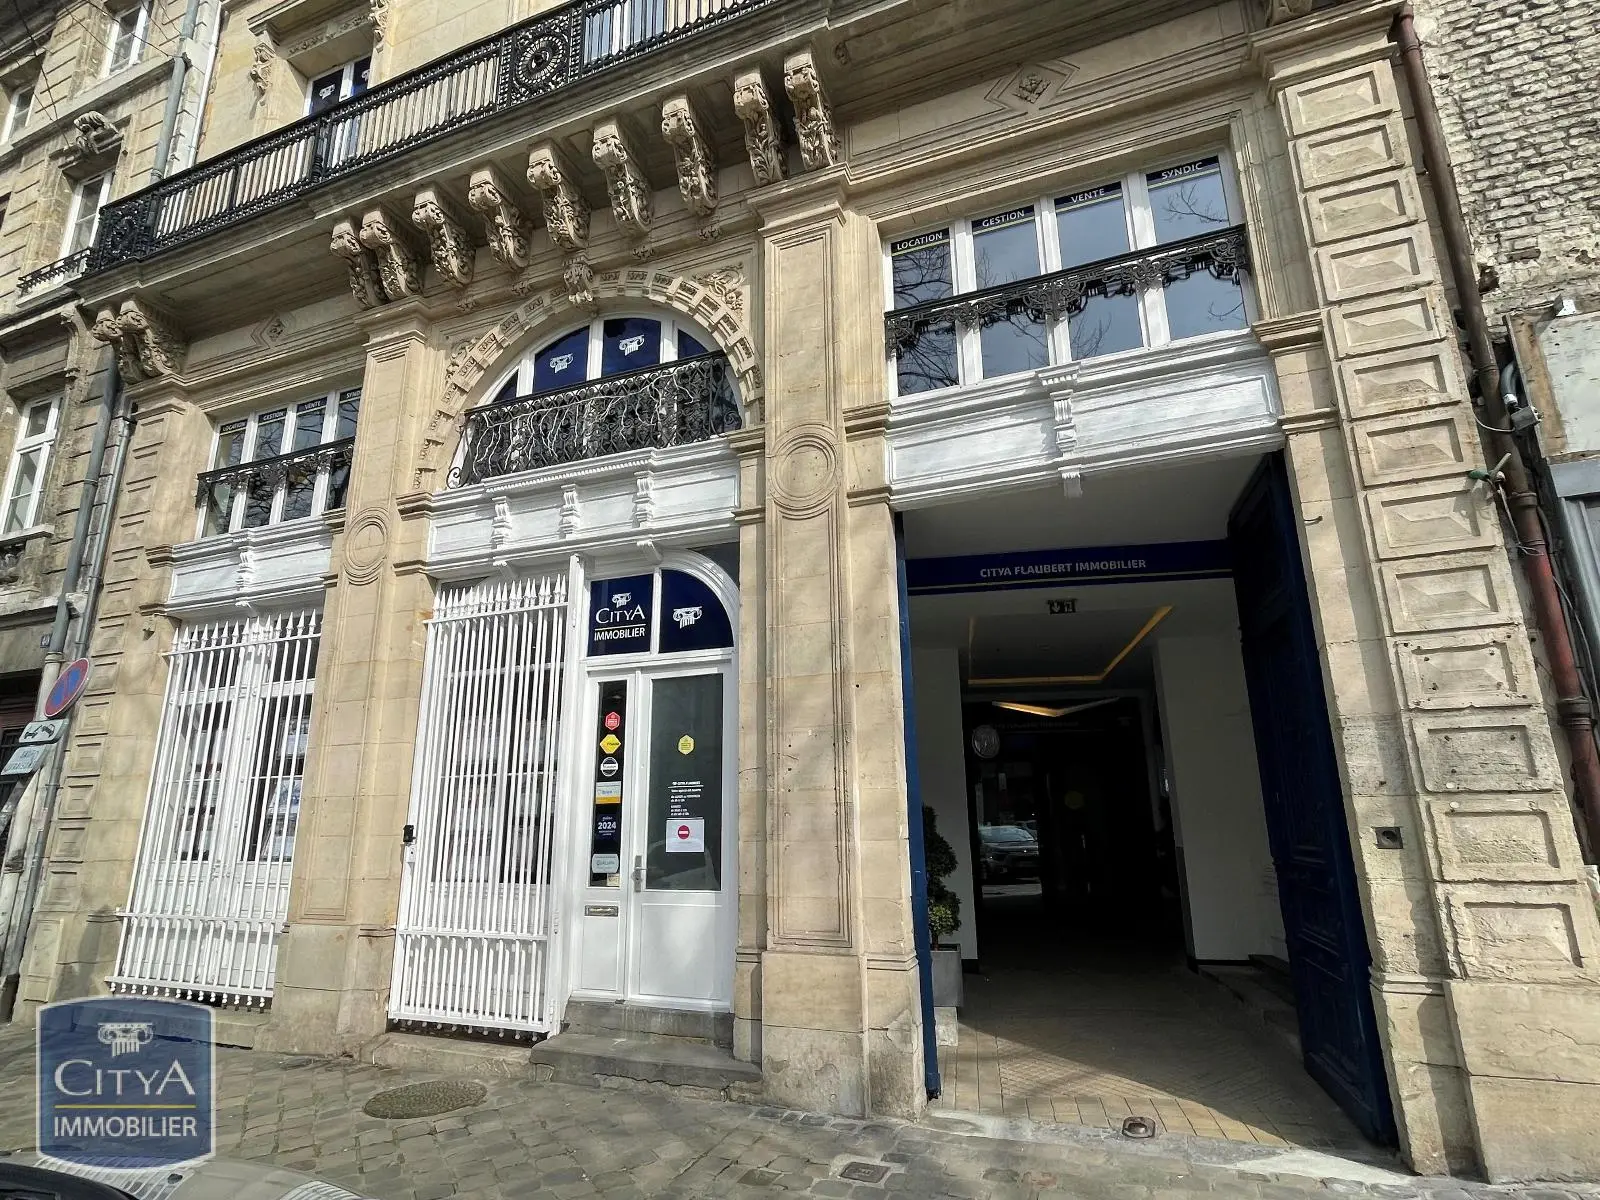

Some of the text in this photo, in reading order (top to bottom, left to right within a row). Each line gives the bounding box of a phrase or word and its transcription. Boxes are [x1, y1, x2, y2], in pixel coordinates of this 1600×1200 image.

[1161, 161, 1204, 180] SYNDIC
[1070, 187, 1106, 205] VENTE
[981, 209, 1026, 228] GESTION
[896, 232, 944, 251] LOCATION
[980, 559, 1147, 578] CITYA FLAUBERT IMMOBILIER
[594, 627, 646, 641] IMMOBILIER
[597, 821, 617, 830] 2024
